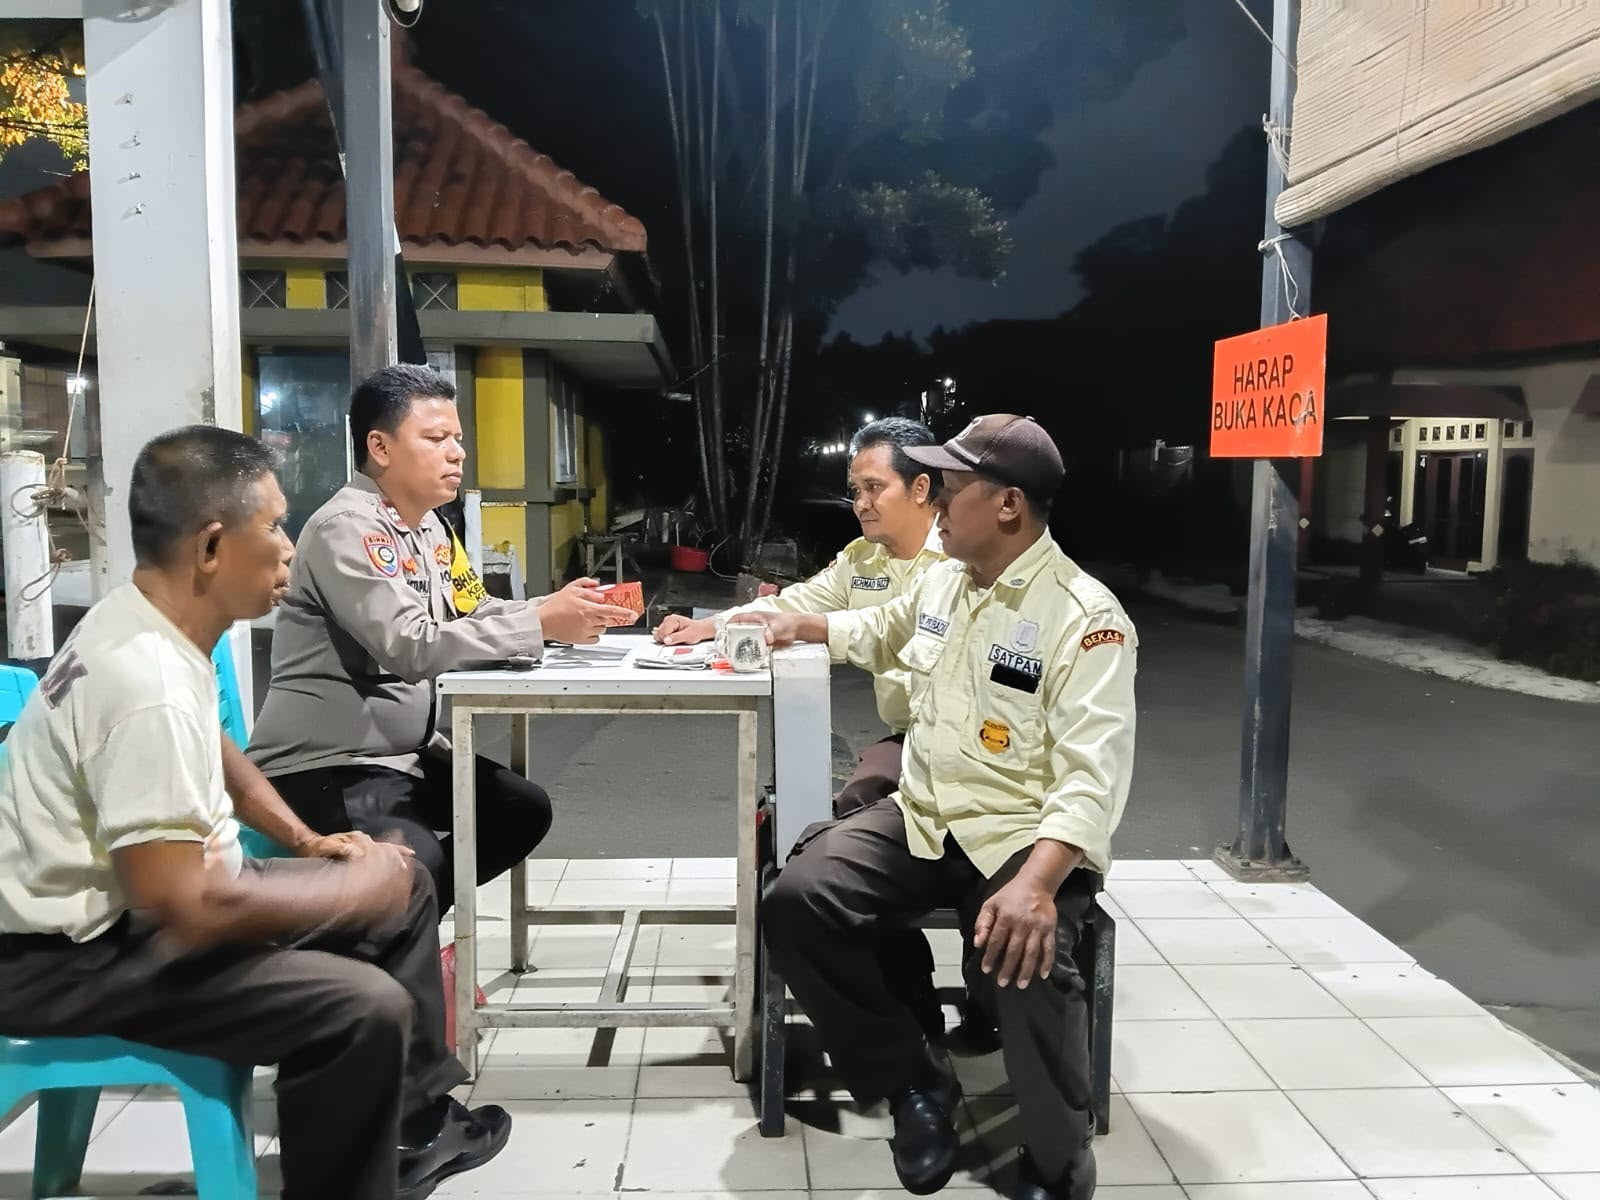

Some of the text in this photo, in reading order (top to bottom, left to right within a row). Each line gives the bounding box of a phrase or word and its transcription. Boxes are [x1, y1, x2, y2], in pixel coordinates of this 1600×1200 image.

[1233, 354, 1294, 395] HARAP
[1213, 390, 1317, 431] BUKA KACA
